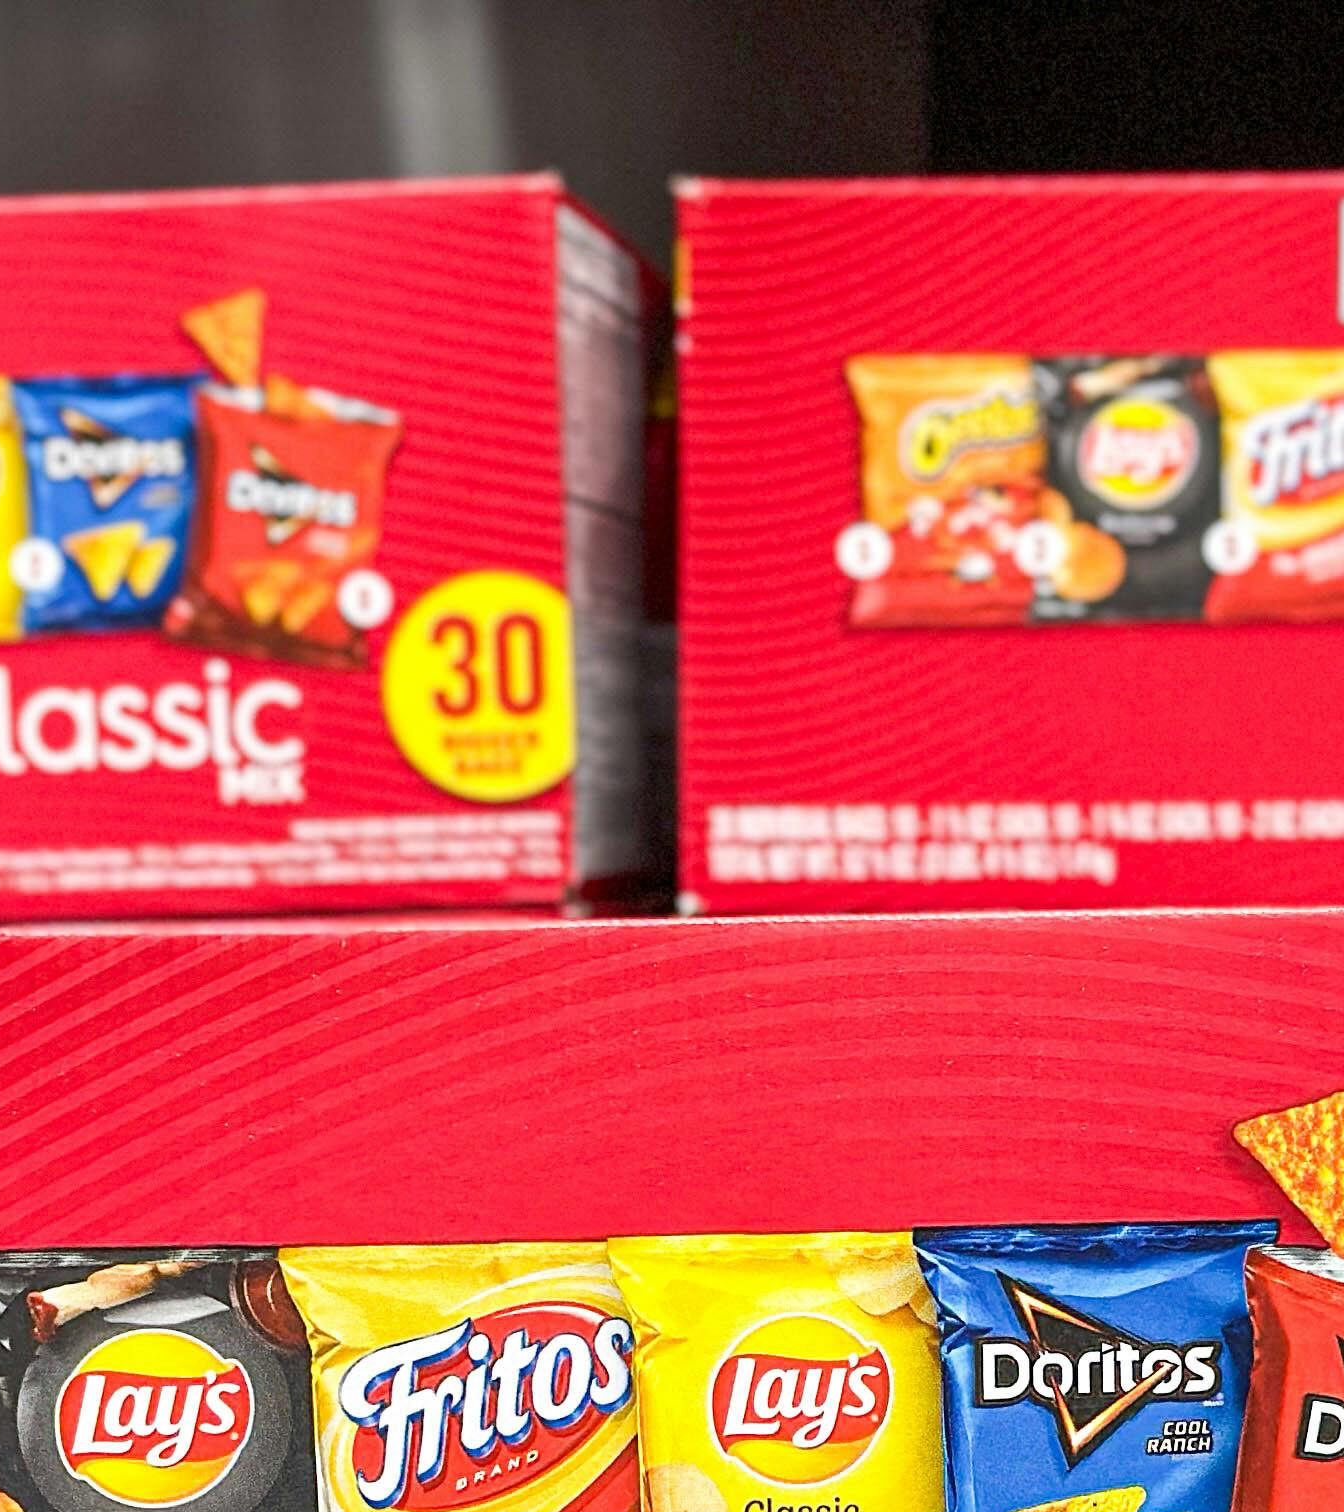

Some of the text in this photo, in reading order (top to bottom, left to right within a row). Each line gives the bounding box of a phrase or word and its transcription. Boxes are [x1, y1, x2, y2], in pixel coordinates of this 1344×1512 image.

[430, 612, 545, 717] 30
[218, 765, 304, 803] MIX
[723, 1352, 879, 1451] Lay's
[982, 1340, 1217, 1404] Doritos
[71, 1368, 238, 1468] Lay's
[342, 1316, 634, 1508] Fritos
[1164, 1420, 1210, 1435] COOL
[455, 1450, 539, 1490] BRAND
[1147, 1437, 1210, 1453] RANCH
